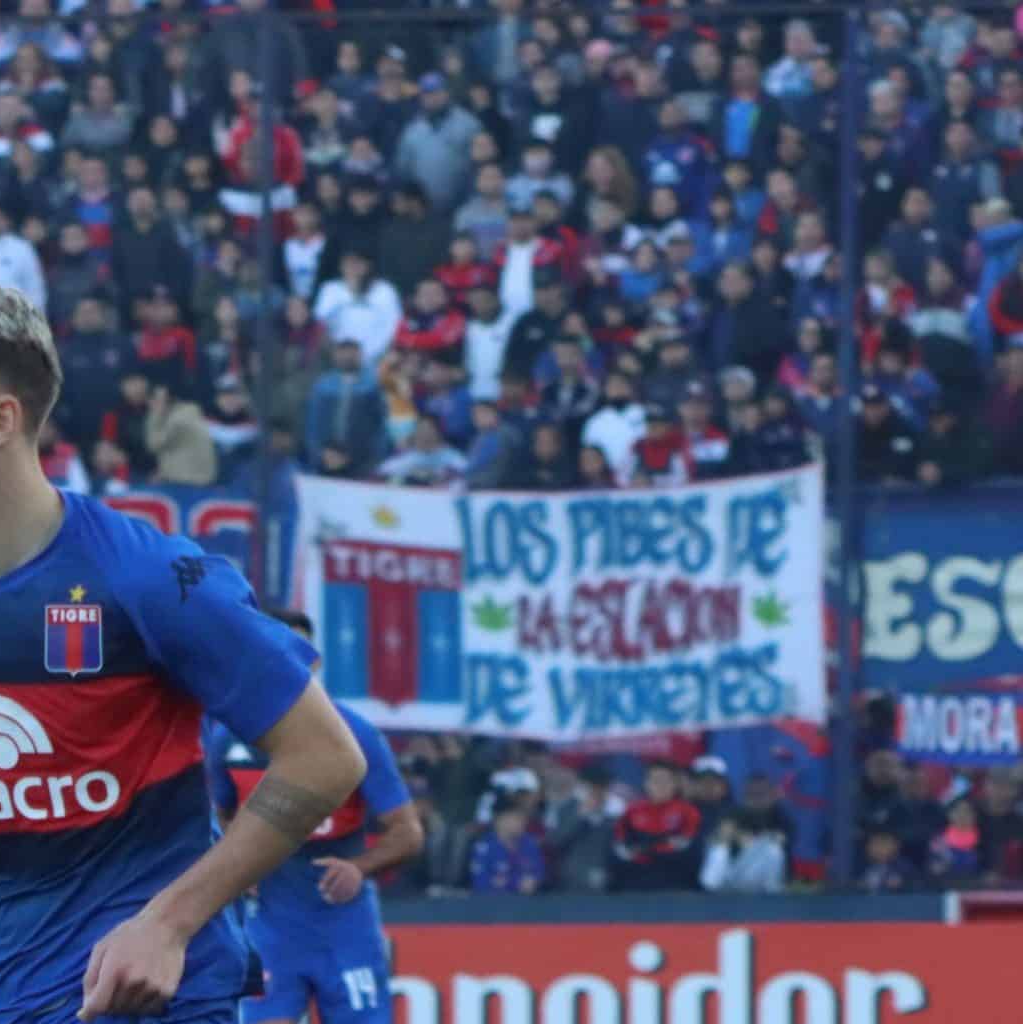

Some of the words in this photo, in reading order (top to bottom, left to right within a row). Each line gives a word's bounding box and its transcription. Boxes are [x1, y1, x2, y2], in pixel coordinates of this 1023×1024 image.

[329, 545, 454, 588] TIGRE
[455, 495, 558, 585] LOS
[567, 493, 715, 574] PIBES
[725, 488, 788, 577] DE
[51, 608, 97, 622] TIGRE
[517, 594, 561, 653] LA
[463, 651, 531, 726] DE
[901, 693, 1020, 754] MORA
